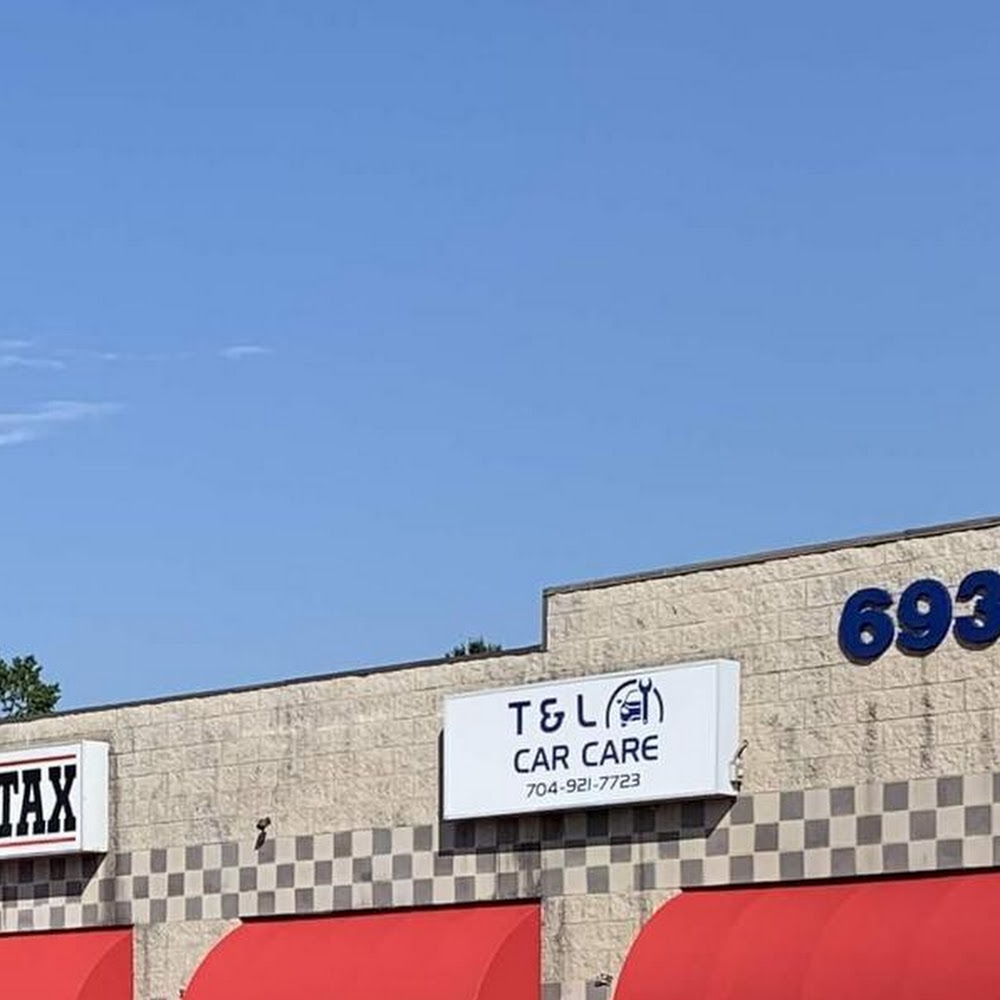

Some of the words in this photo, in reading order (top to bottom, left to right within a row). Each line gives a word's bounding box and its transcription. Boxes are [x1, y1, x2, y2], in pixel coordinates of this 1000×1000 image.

[838, 569, 1000, 665] 693
[508, 700, 531, 735] T
[540, 697, 565, 733] &
[577, 694, 597, 727] L
[514, 744, 569, 773] CAR
[582, 735, 659, 767] CARE
[526, 773, 641, 798] 704-921-7723
